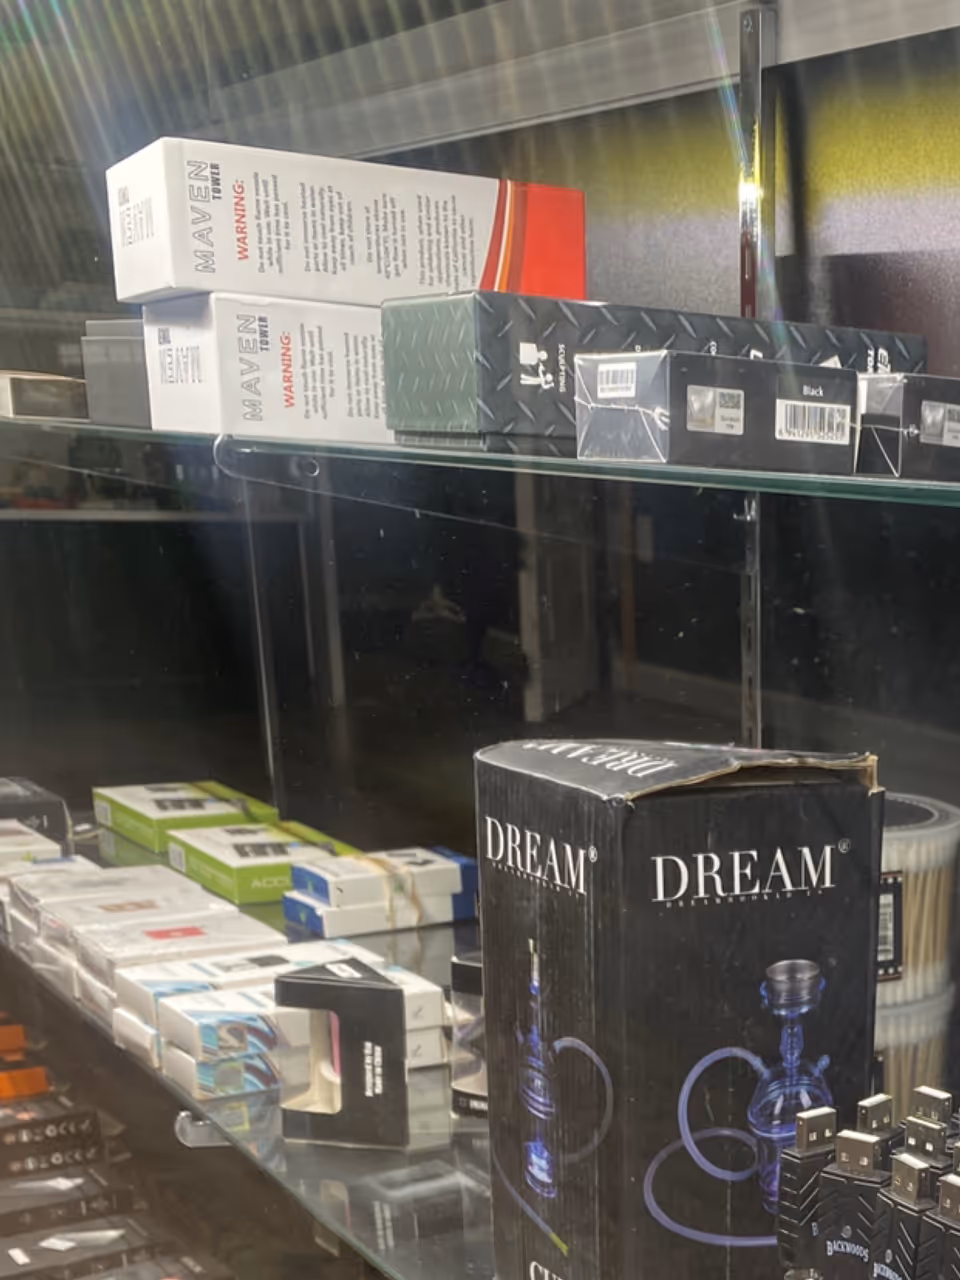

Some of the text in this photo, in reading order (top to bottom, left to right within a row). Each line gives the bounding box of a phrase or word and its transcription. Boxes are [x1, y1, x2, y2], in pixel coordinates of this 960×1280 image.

[210, 163, 222, 200] TOWER
[187, 160, 215, 273] MAVEN
[233, 179, 249, 260] WARNING:
[258, 316, 269, 352] TOWER
[237, 314, 262, 421] MAVEN
[280, 331, 295, 408] WARNING:
[558, 343, 566, 393] SCULPTING
[802, 384, 824, 397] Black
[826, 1240, 870, 1263] BACKWOODS
